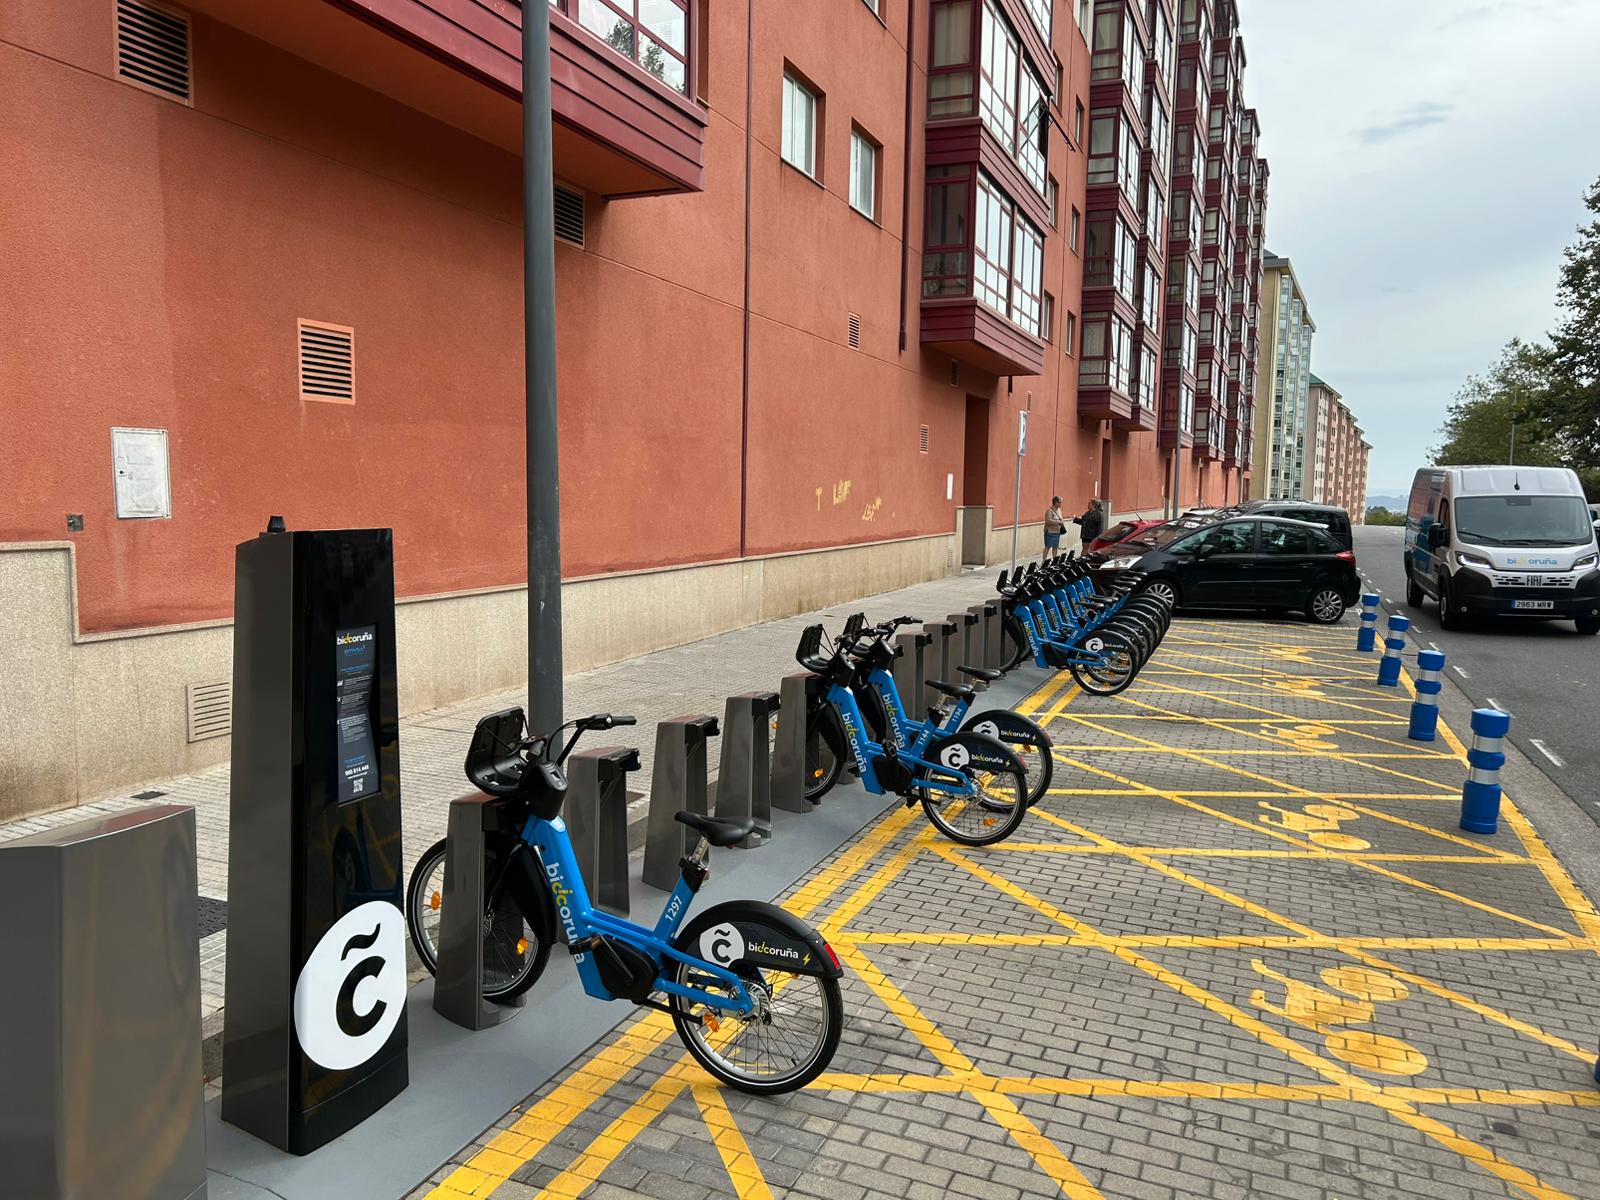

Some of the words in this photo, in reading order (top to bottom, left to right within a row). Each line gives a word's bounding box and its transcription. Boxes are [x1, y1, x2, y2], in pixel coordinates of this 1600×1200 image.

[1526, 575, 1543, 586] FIAT
[545, 862, 585, 964] bicicorua
[665, 895, 683, 922] 1297
